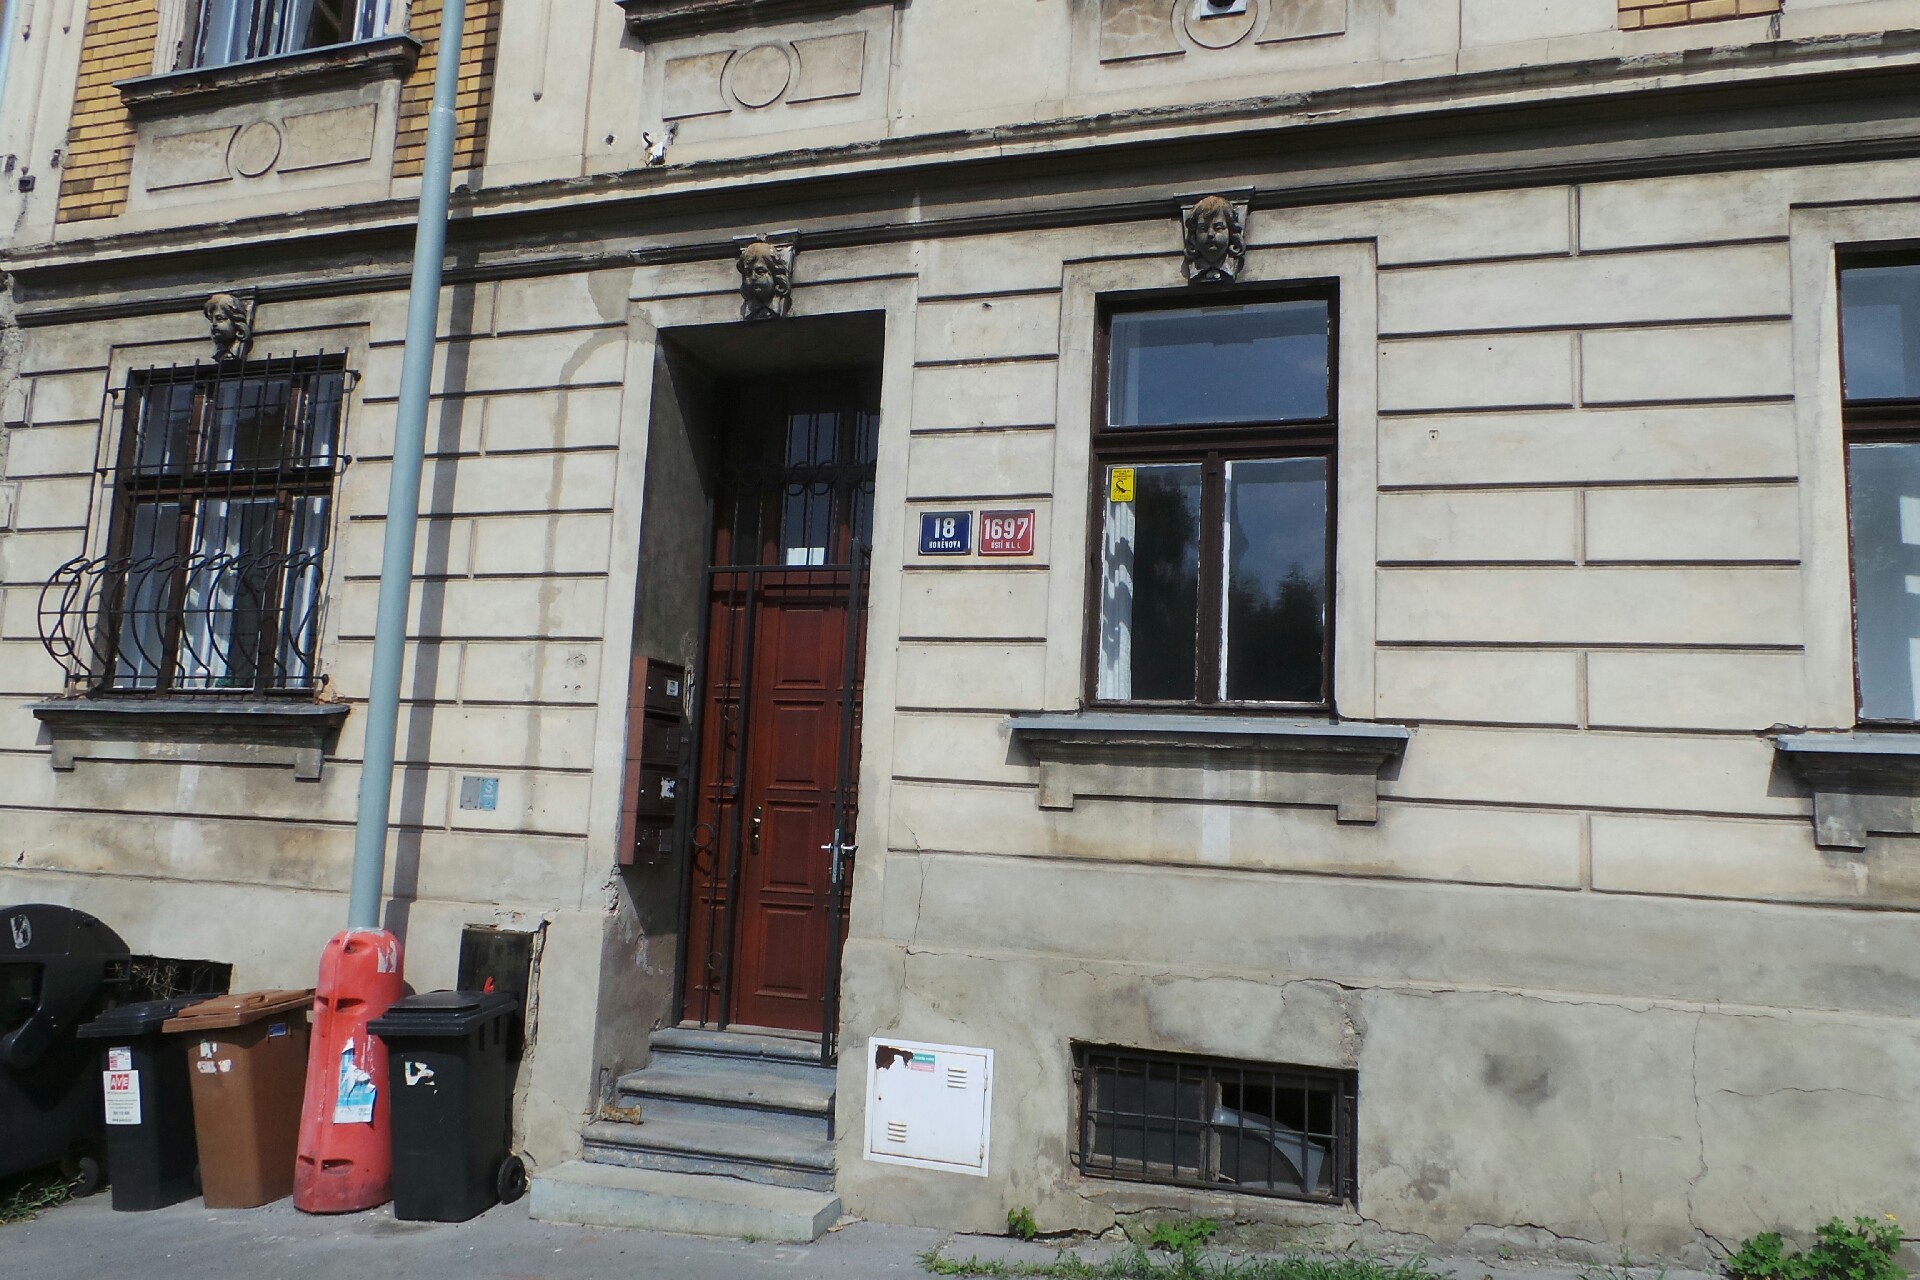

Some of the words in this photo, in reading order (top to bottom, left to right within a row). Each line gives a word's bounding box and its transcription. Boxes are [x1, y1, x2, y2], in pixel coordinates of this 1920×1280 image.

[935, 518, 955, 539] 18
[985, 518, 1029, 540] 1697
[110, 1075, 129, 1089] AVE
